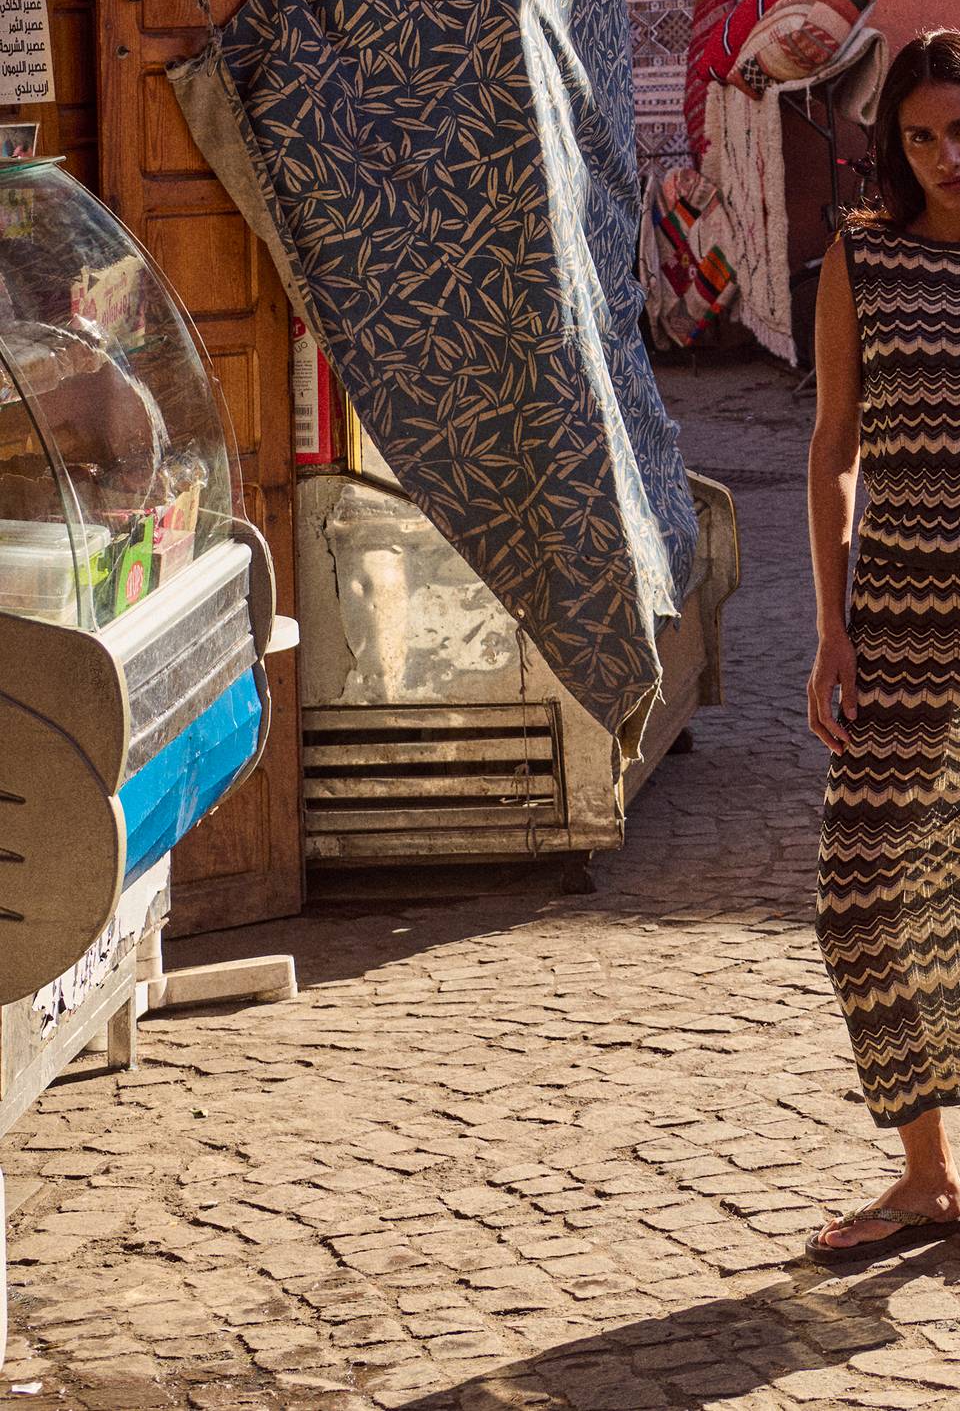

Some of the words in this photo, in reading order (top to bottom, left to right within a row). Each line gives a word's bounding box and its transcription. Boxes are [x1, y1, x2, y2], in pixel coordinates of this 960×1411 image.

[23, 1, 41, 14] عصير
[25, 22, 43, 34] عصير
[26, 42, 45, 56] عصير
[2, 61, 26, 77] الليمون
[28, 63, 47, 76] عصير
[15, 81, 32, 101] بلدي
